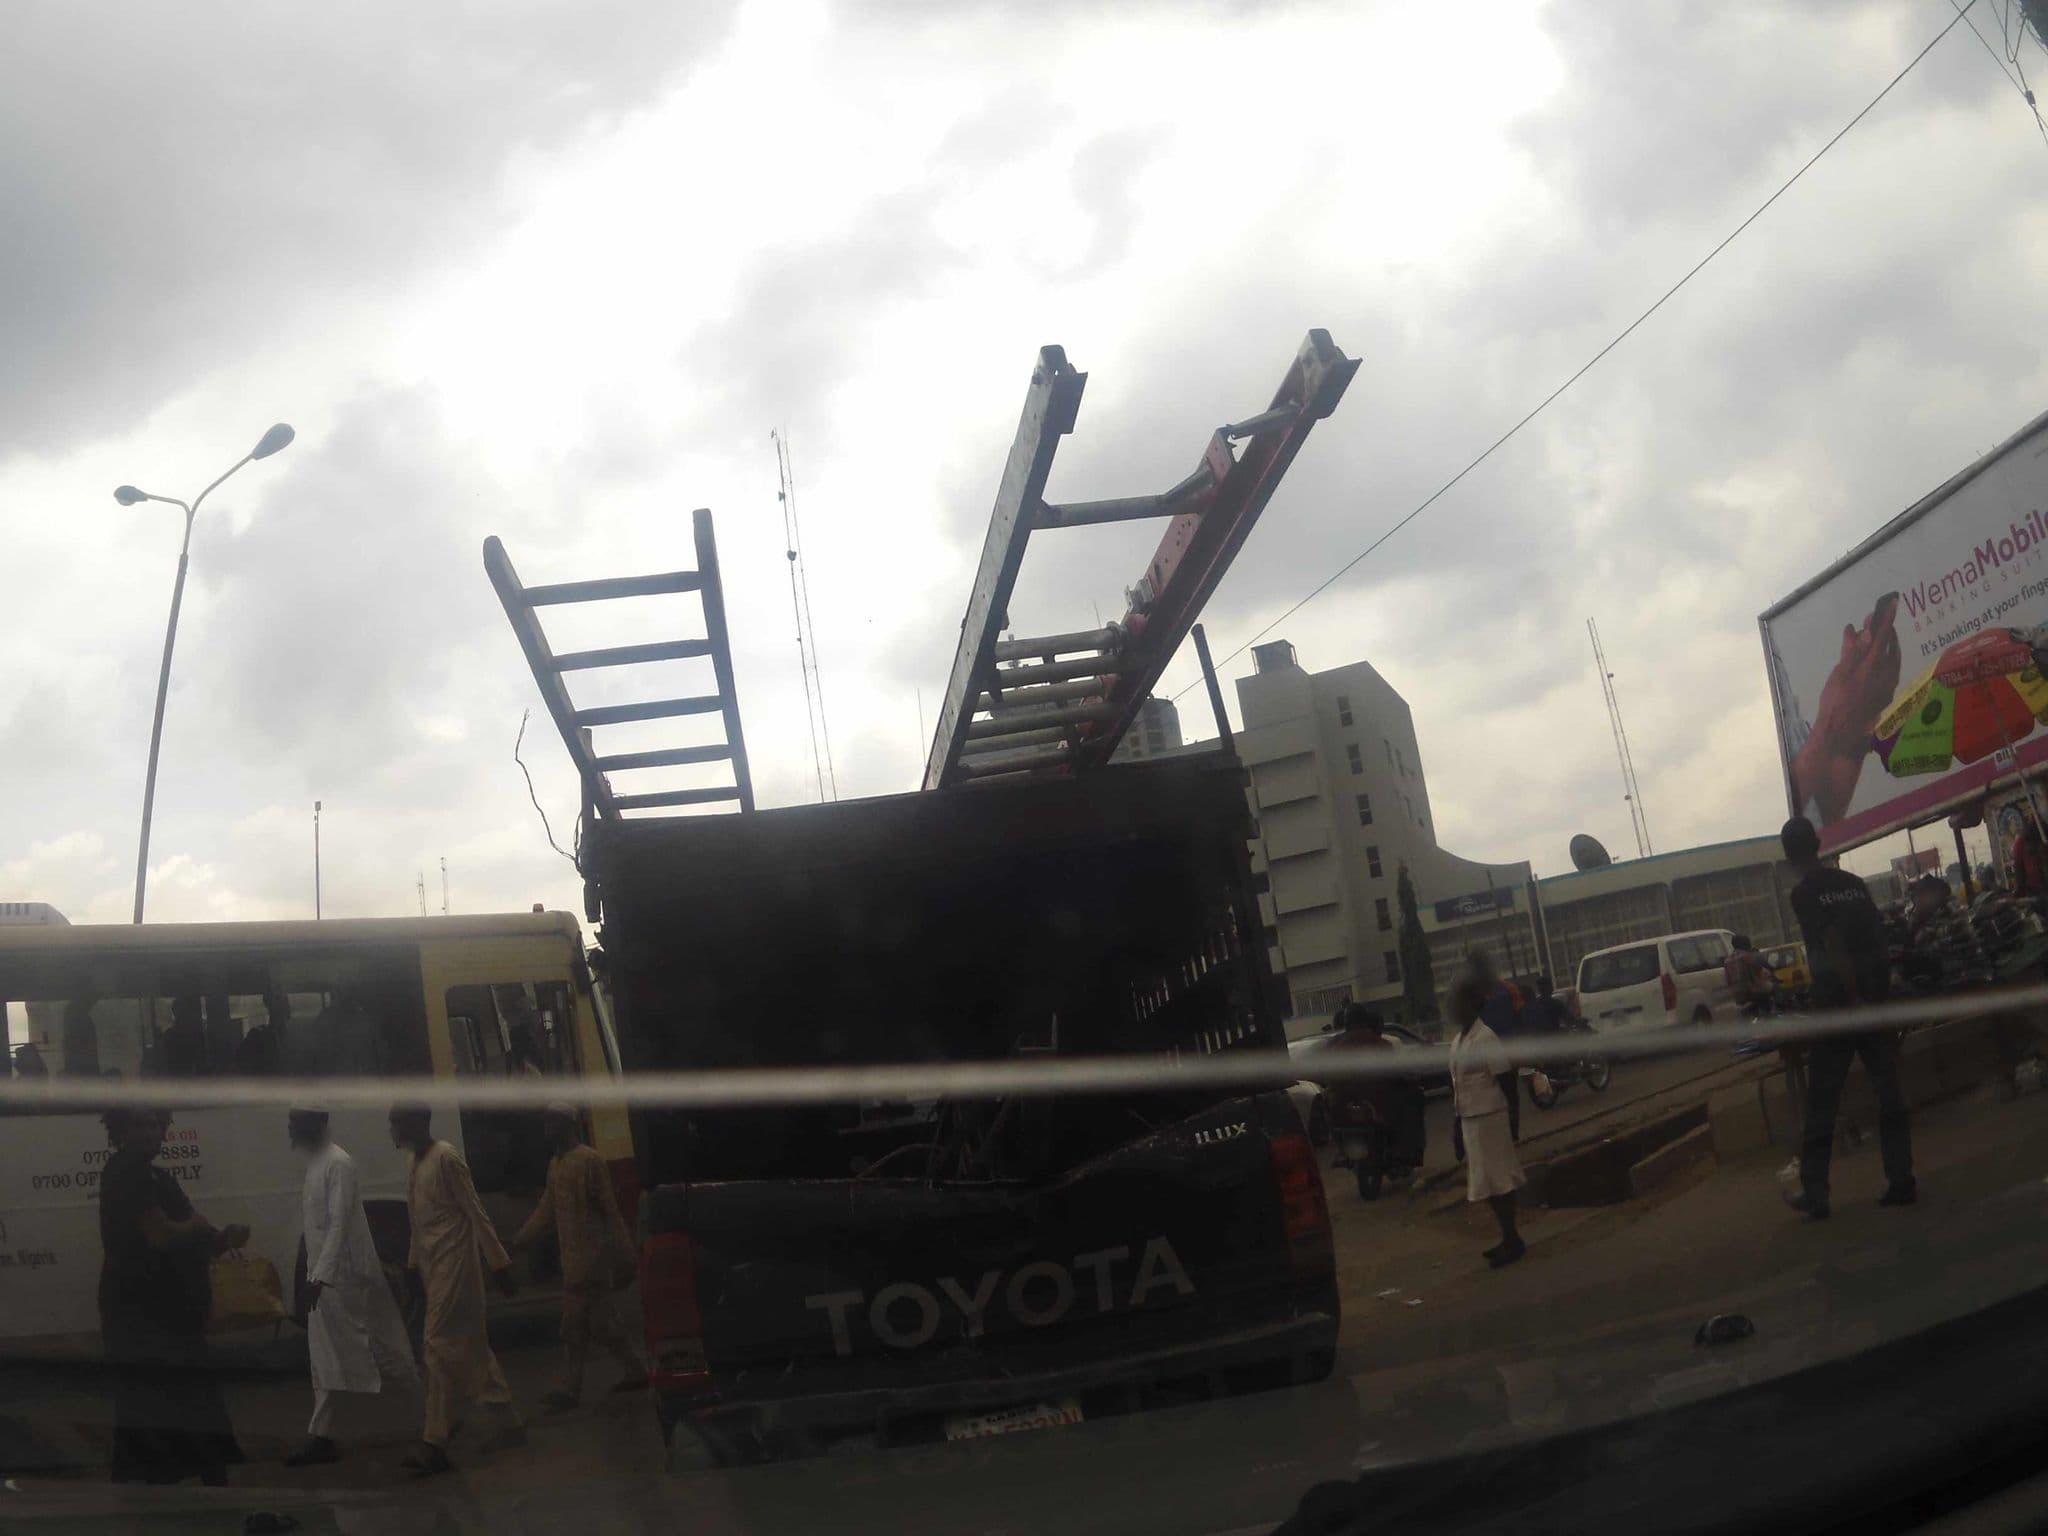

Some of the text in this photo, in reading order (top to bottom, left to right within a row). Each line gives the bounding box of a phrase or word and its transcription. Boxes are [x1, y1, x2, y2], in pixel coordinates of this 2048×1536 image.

[1921, 637, 1938, 656] It's
[1938, 617, 1981, 647] banking
[1982, 609, 1994, 624] at
[1993, 595, 2020, 620] your
[804, 1234, 1198, 1357] TOYOTA
